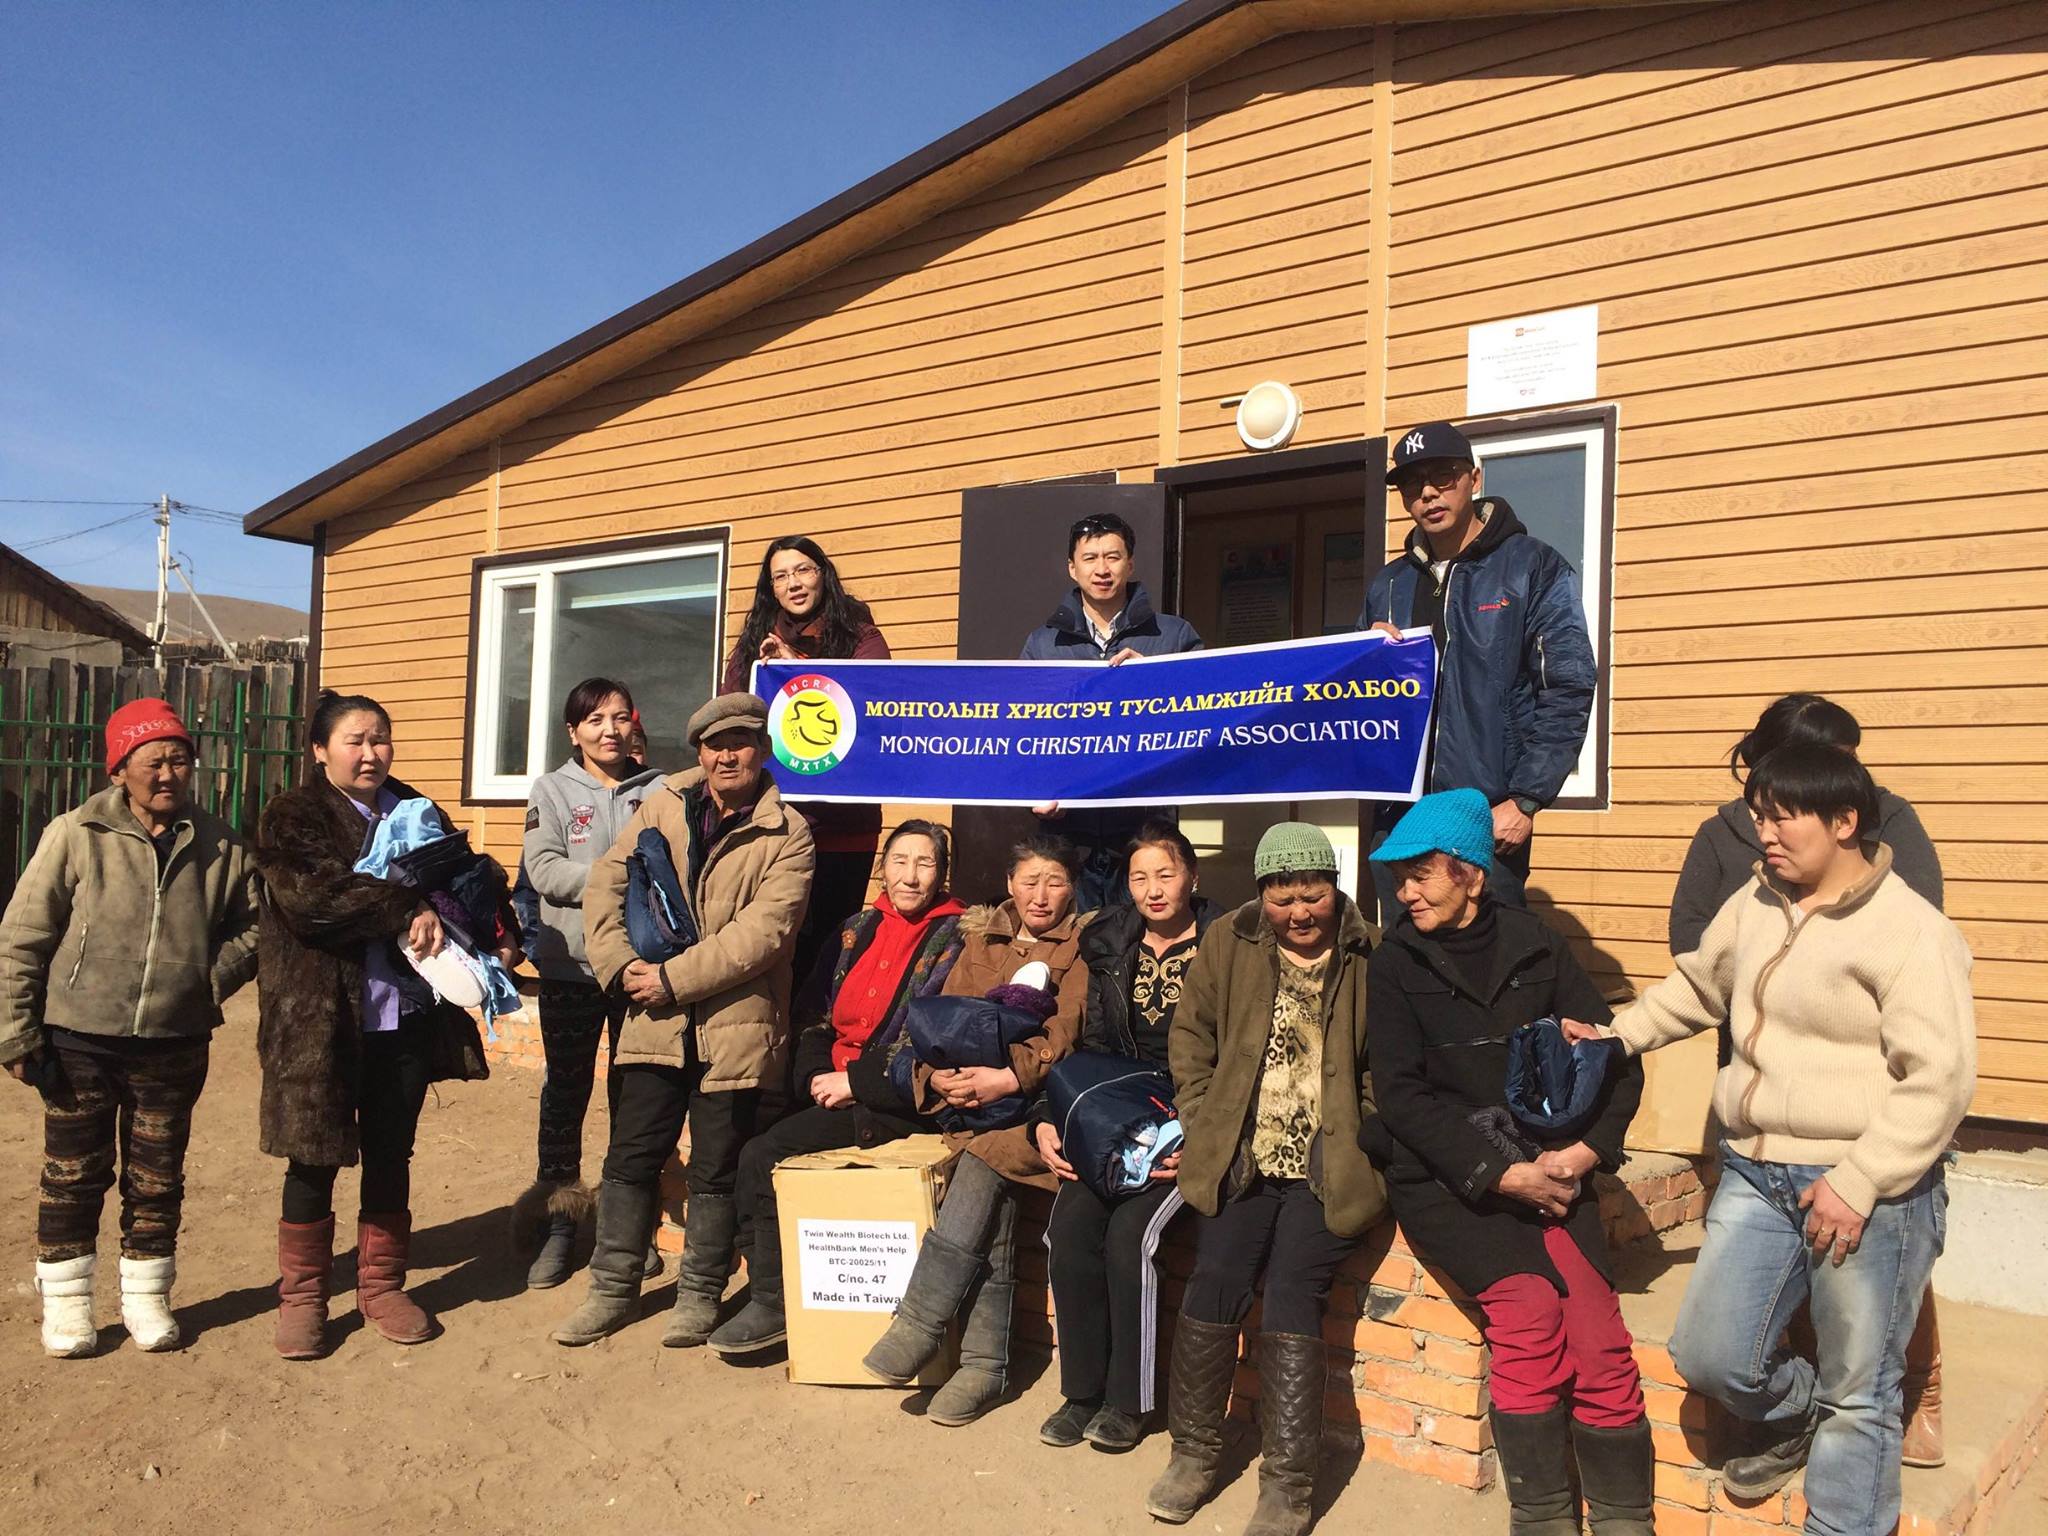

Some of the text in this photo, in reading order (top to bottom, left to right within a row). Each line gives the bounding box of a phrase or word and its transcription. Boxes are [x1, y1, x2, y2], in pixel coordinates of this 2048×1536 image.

[790, 679, 832, 692] MCRA
[865, 678, 1421, 719] МОНГОЛЫН ХРИСТЭЧ ТУСЛАМЖИЙН ХОЛБОО
[880, 719, 1401, 755] MONGOLIAN CHRISTIAN RELIEF ASSOCIATION
[804, 1230, 910, 1240] Twin Wealth Biotech Ltd.
[808, 1244, 907, 1255] HealthBank Men's Help
[838, 1273, 887, 1284] C/no. 47
[812, 1291, 903, 1304] Made in Taiwa
